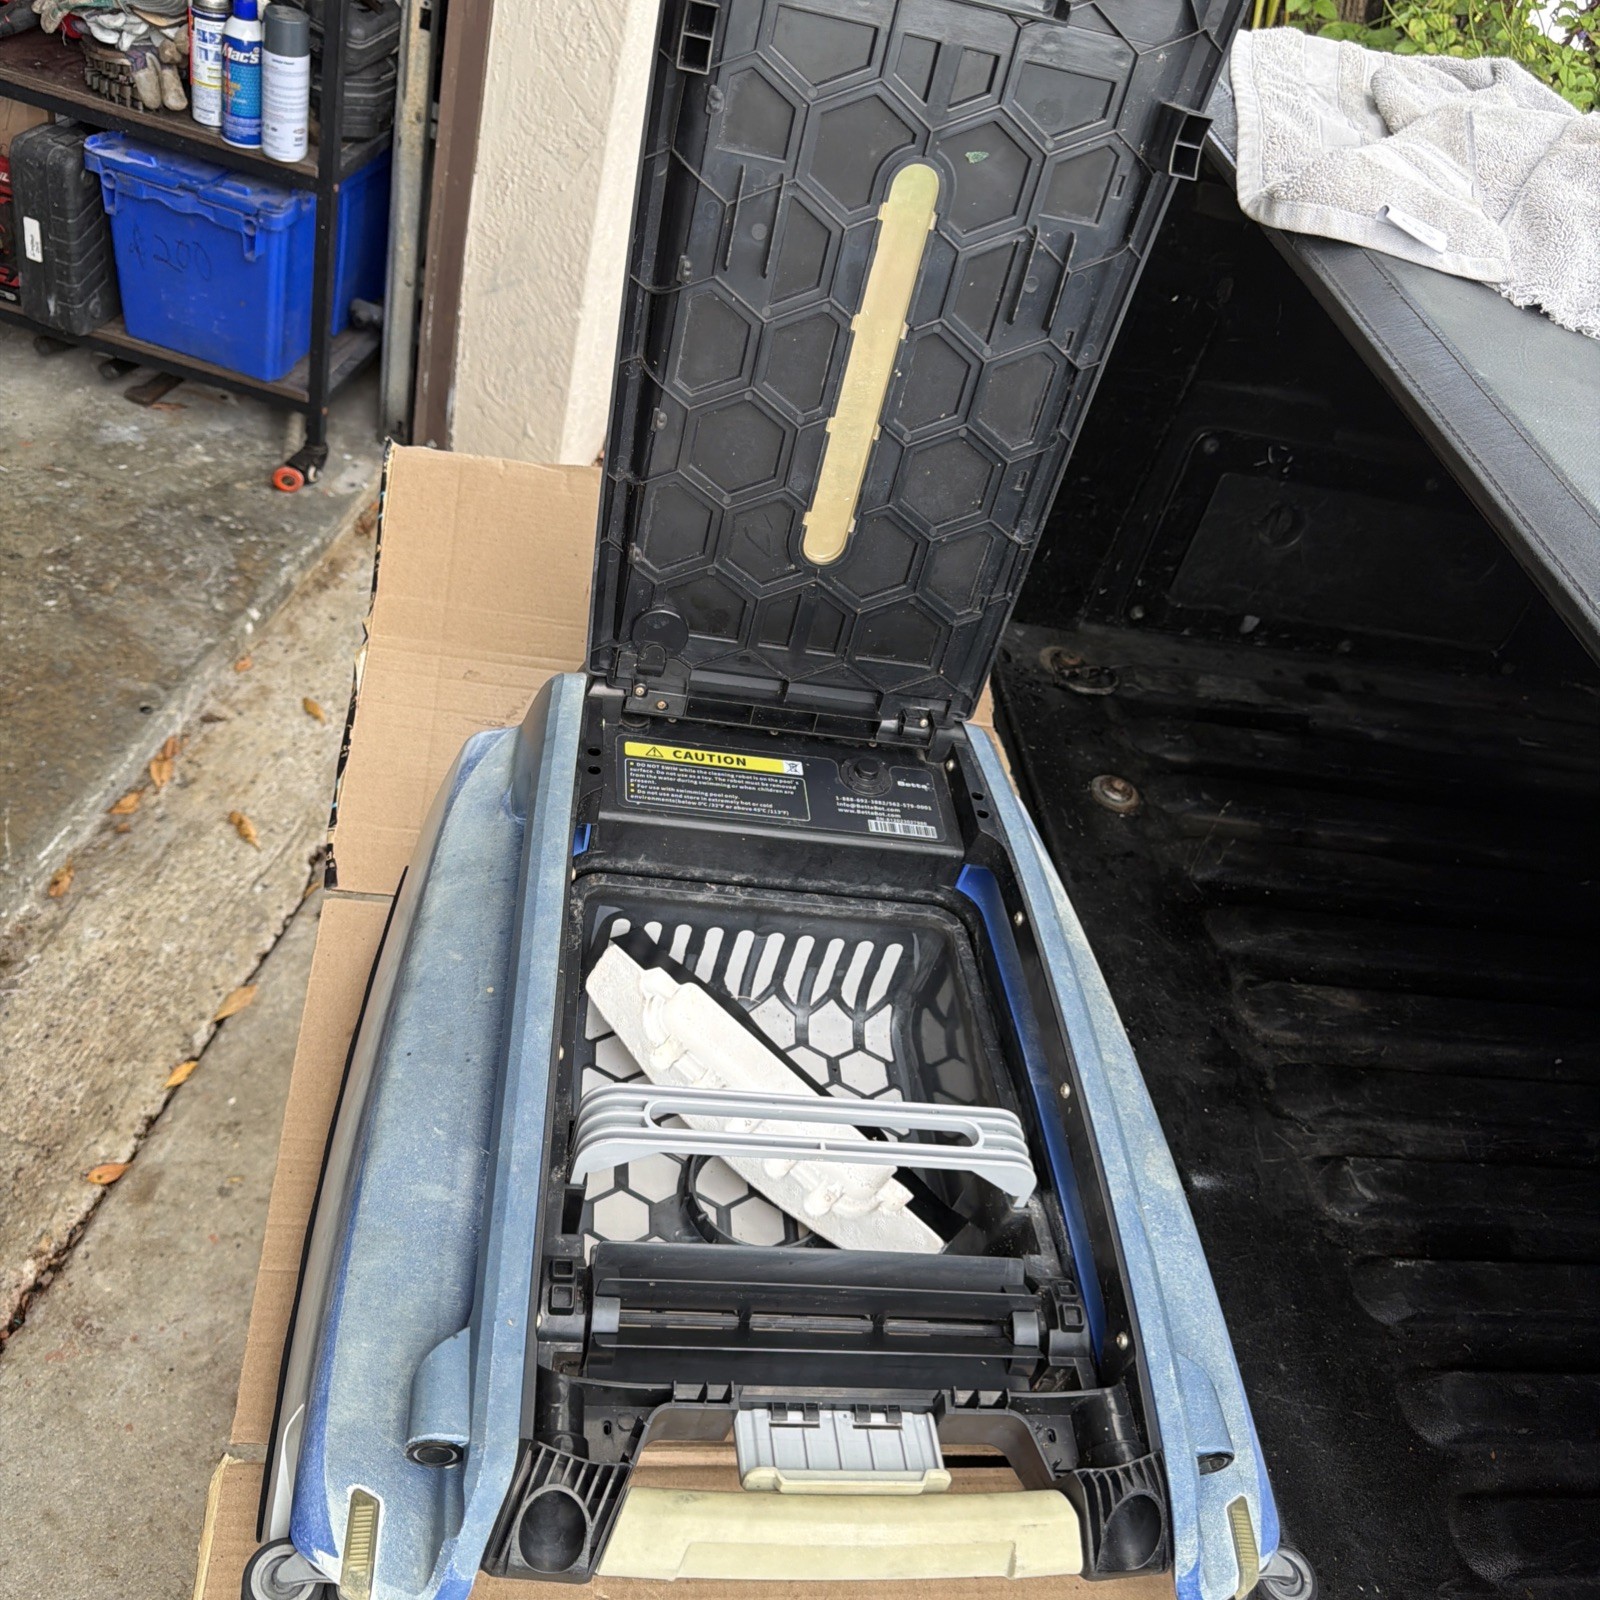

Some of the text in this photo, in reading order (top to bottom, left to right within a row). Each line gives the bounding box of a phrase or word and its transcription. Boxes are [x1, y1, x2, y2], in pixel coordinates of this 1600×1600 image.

[672, 750, 746, 766] CAUTION
[708, 769, 734, 778] cleaning
[676, 776, 698, 785] during
[699, 780, 731, 789] swimming
[676, 788, 708, 797] swimming
